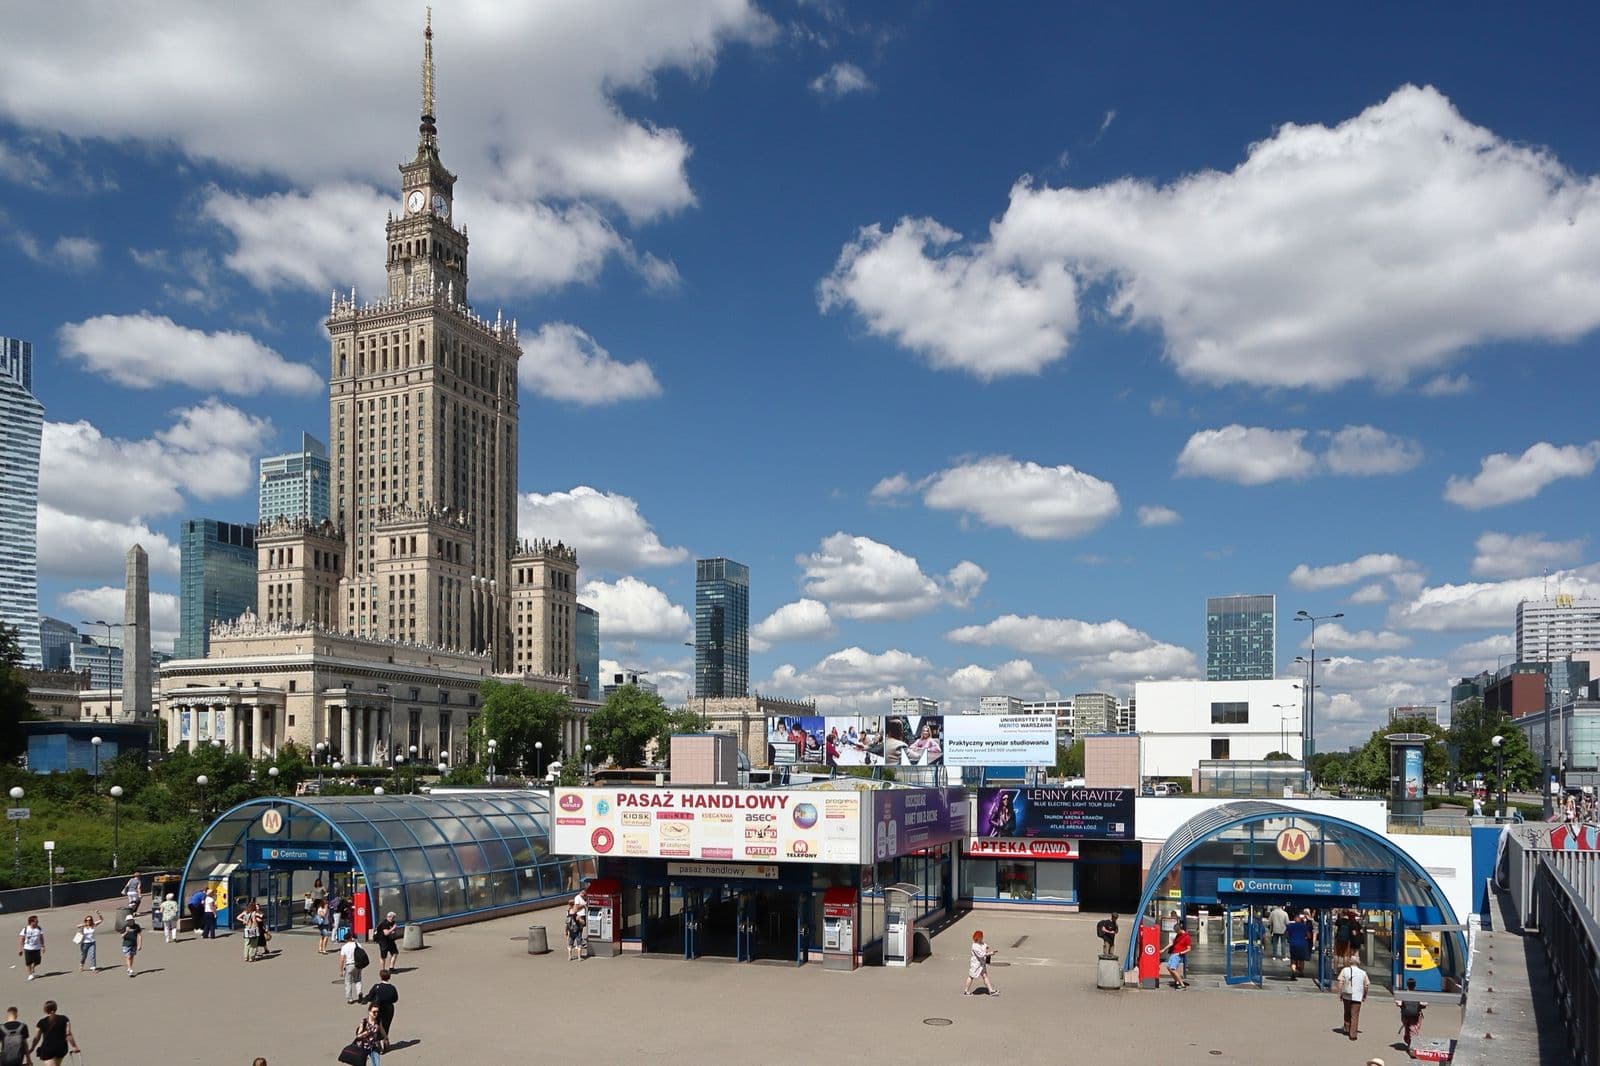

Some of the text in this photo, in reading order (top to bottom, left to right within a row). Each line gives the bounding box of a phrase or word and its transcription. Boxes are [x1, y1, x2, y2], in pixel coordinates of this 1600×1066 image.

[617, 790, 674, 808] PASAŻ
[681, 794, 789, 809] HANDLOWY
[1027, 790, 1123, 802] LENNY KRAVITZ
[971, 841, 1067, 855] APTEKA WAWA
[1280, 832, 1306, 855] M
[280, 850, 308, 858] Centrum
[746, 847, 776, 855] APTEKA
[706, 866, 746, 876] handlowy
[1248, 880, 1293, 892] Centrum
